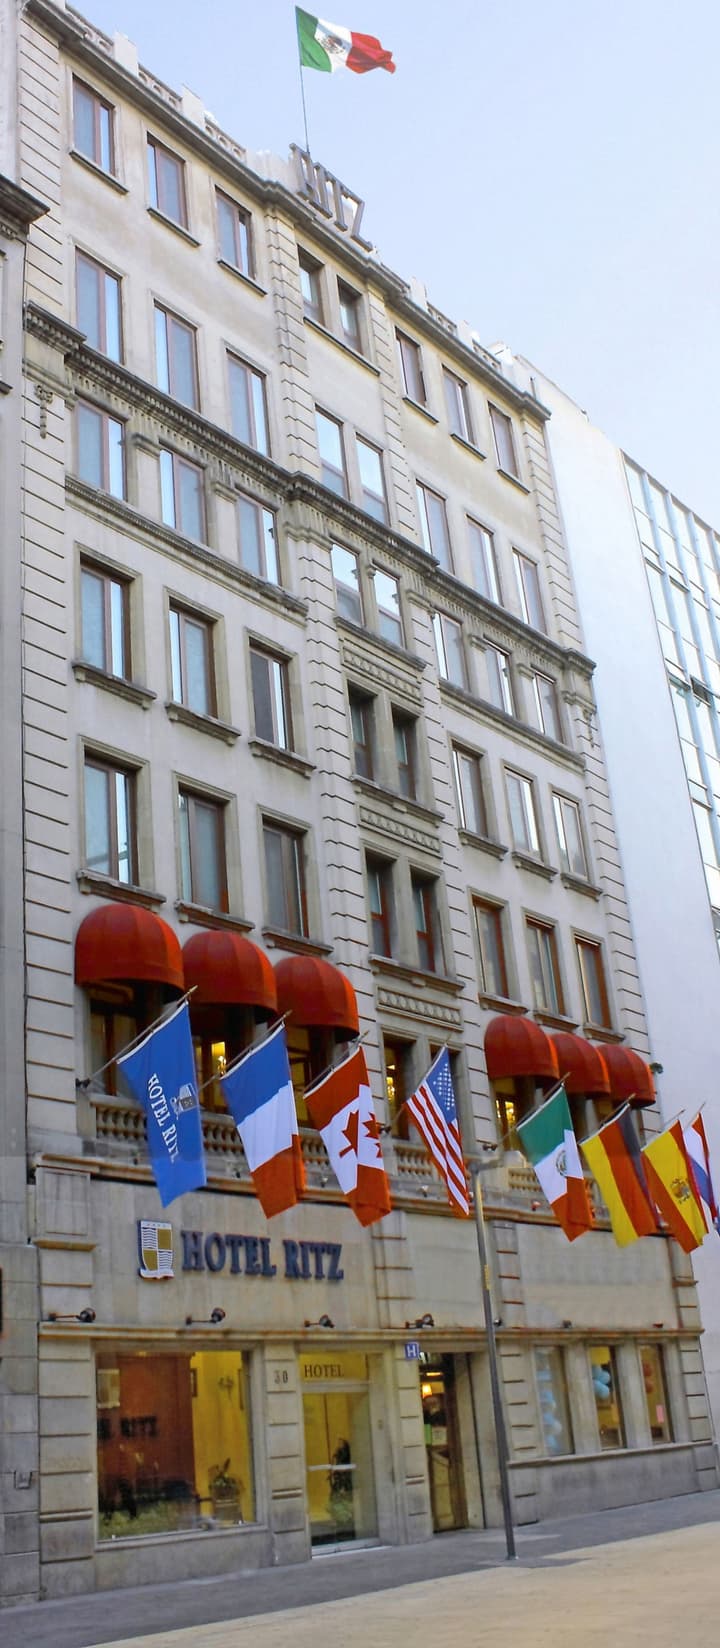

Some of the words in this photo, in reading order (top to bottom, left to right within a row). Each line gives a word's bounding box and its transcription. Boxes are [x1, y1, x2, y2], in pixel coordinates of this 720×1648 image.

[288, 142, 373, 252] RITZ
[148, 1073, 171, 1127] HOTEL
[180, 1229, 277, 1278] HOTEL
[282, 1239, 344, 1281] RITZ
[304, 1364, 345, 1379] HOTEL
